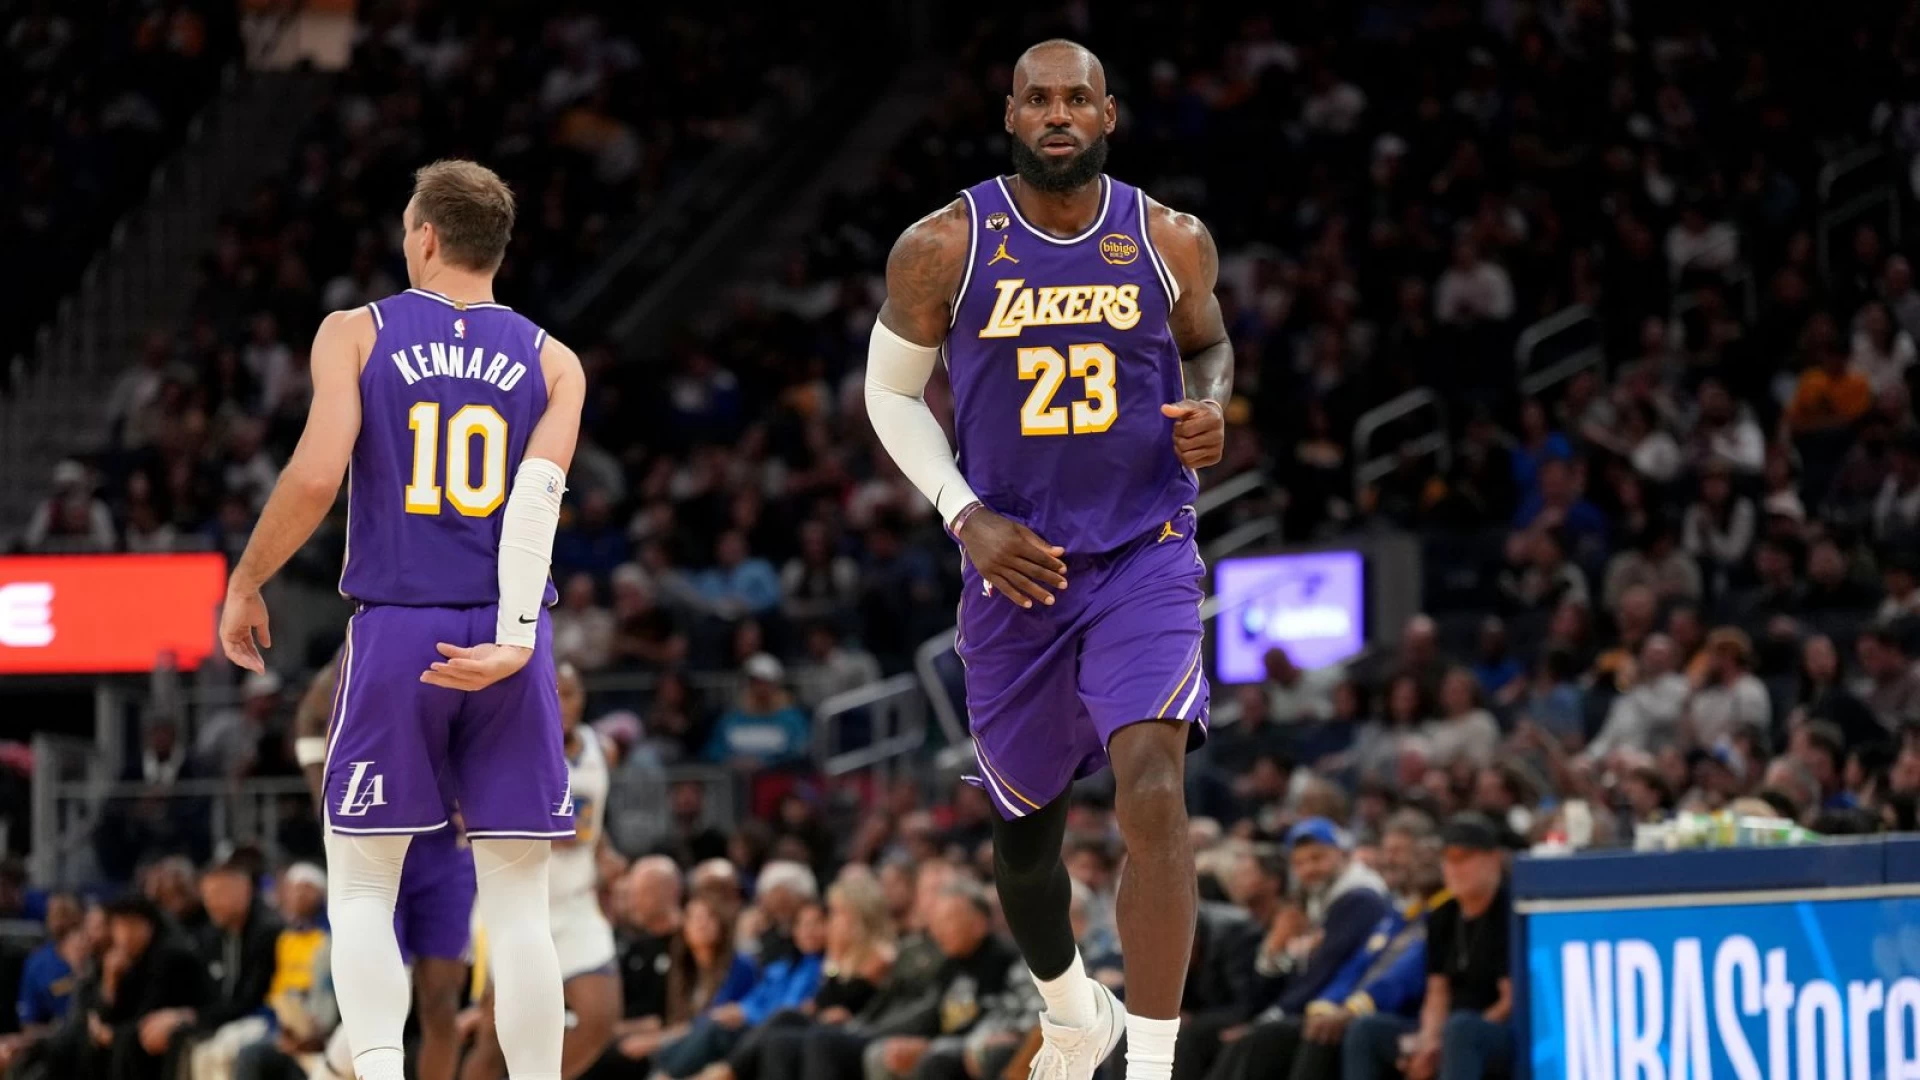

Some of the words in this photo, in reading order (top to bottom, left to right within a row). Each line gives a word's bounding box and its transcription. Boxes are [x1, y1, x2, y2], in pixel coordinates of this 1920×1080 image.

[1103, 241, 1136, 256] bibigo
[978, 278, 1142, 339] LAKERS
[391, 342, 527, 392] KENNARD
[1017, 343, 1118, 436] 23
[405, 401, 508, 518] 10
[335, 761, 388, 817] LA
